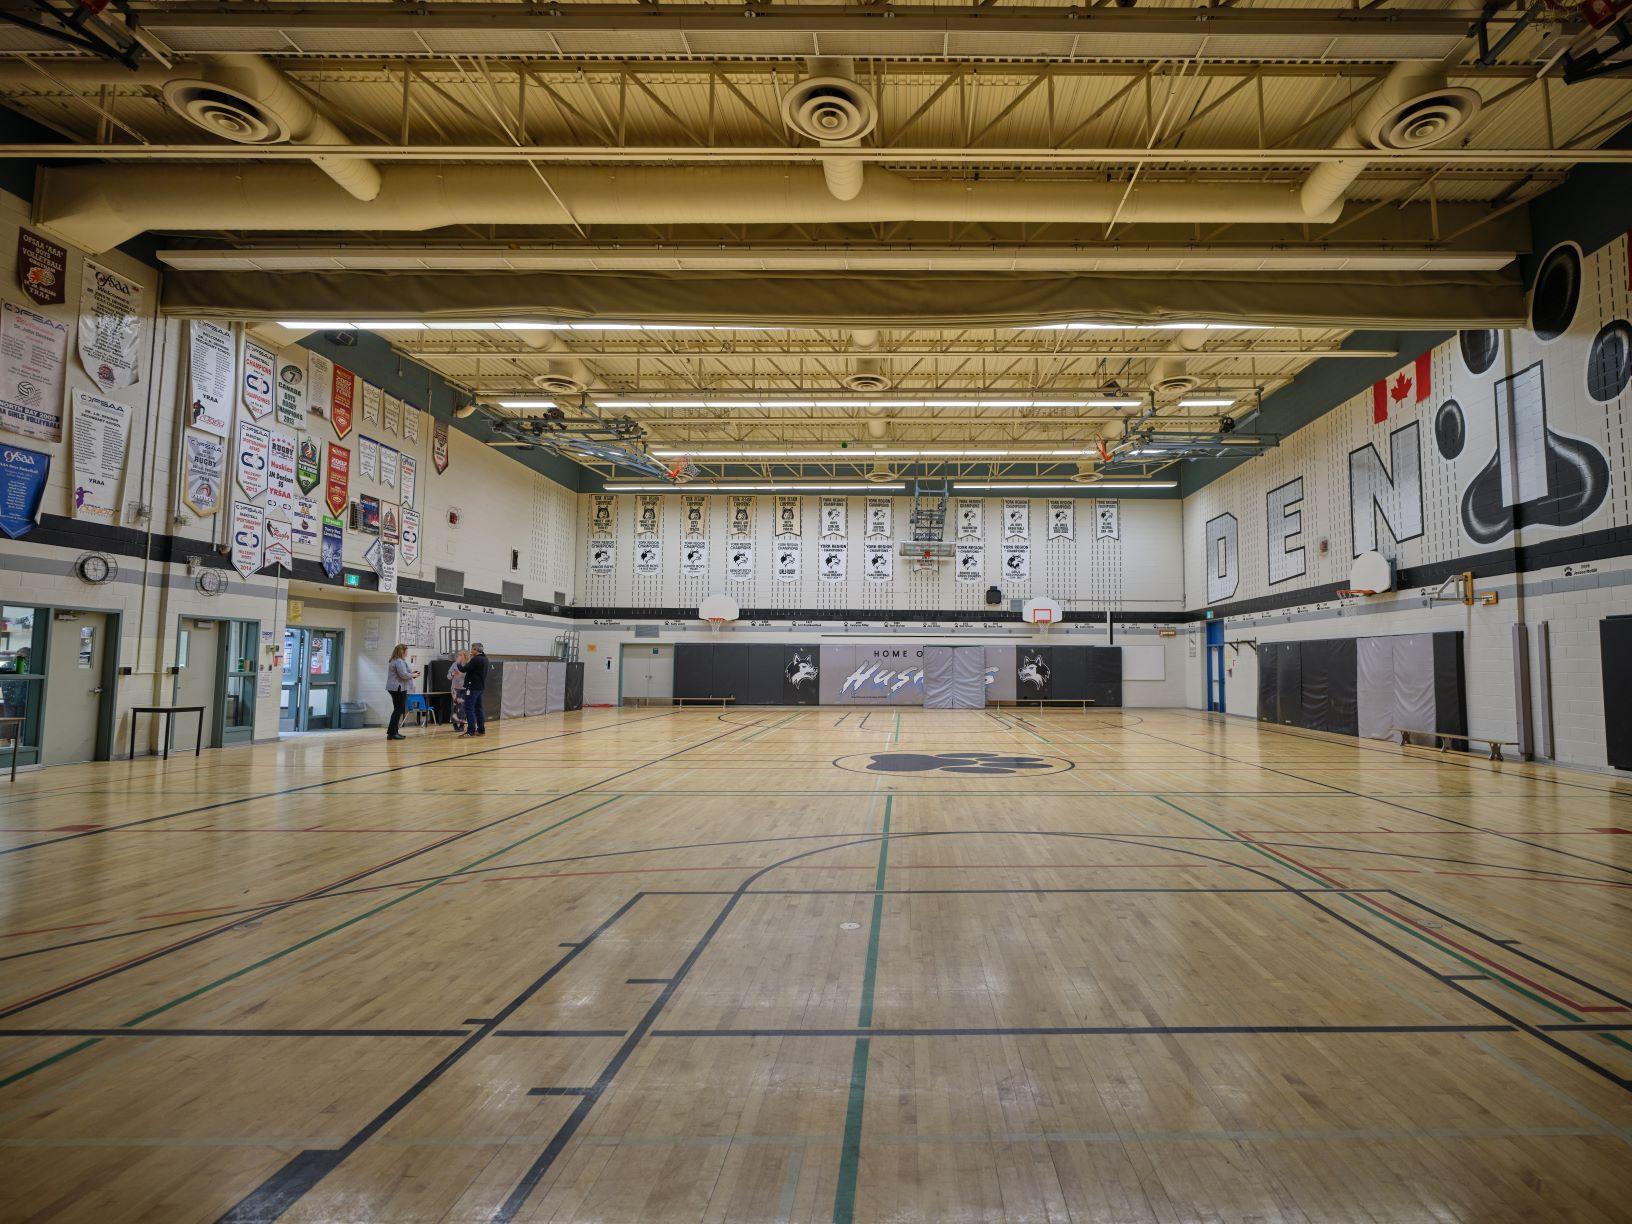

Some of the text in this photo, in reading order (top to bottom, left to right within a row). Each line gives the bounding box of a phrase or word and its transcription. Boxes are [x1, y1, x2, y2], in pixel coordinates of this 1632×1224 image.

[22, 248, 62, 270] VOLLEYBALL
[246, 358, 272, 376] CHAMPIONS
[278, 382, 302, 396] CANADA
[202, 394, 218, 404] YRAA
[284, 393, 296, 402] BOYS
[8, 410, 60, 429] GIRLS VOLLEYBALL
[24, 410, 38, 418] BAY
[272, 443, 294, 456] RUGBY
[194, 456, 216, 468] RUGBY
[270, 460, 293, 474] Huskies
[276, 474, 294, 484] Denison
[270, 488, 292, 500] YRSAA
[273, 529, 290, 540] Rugby
[840, 660, 1000, 694] Huss
